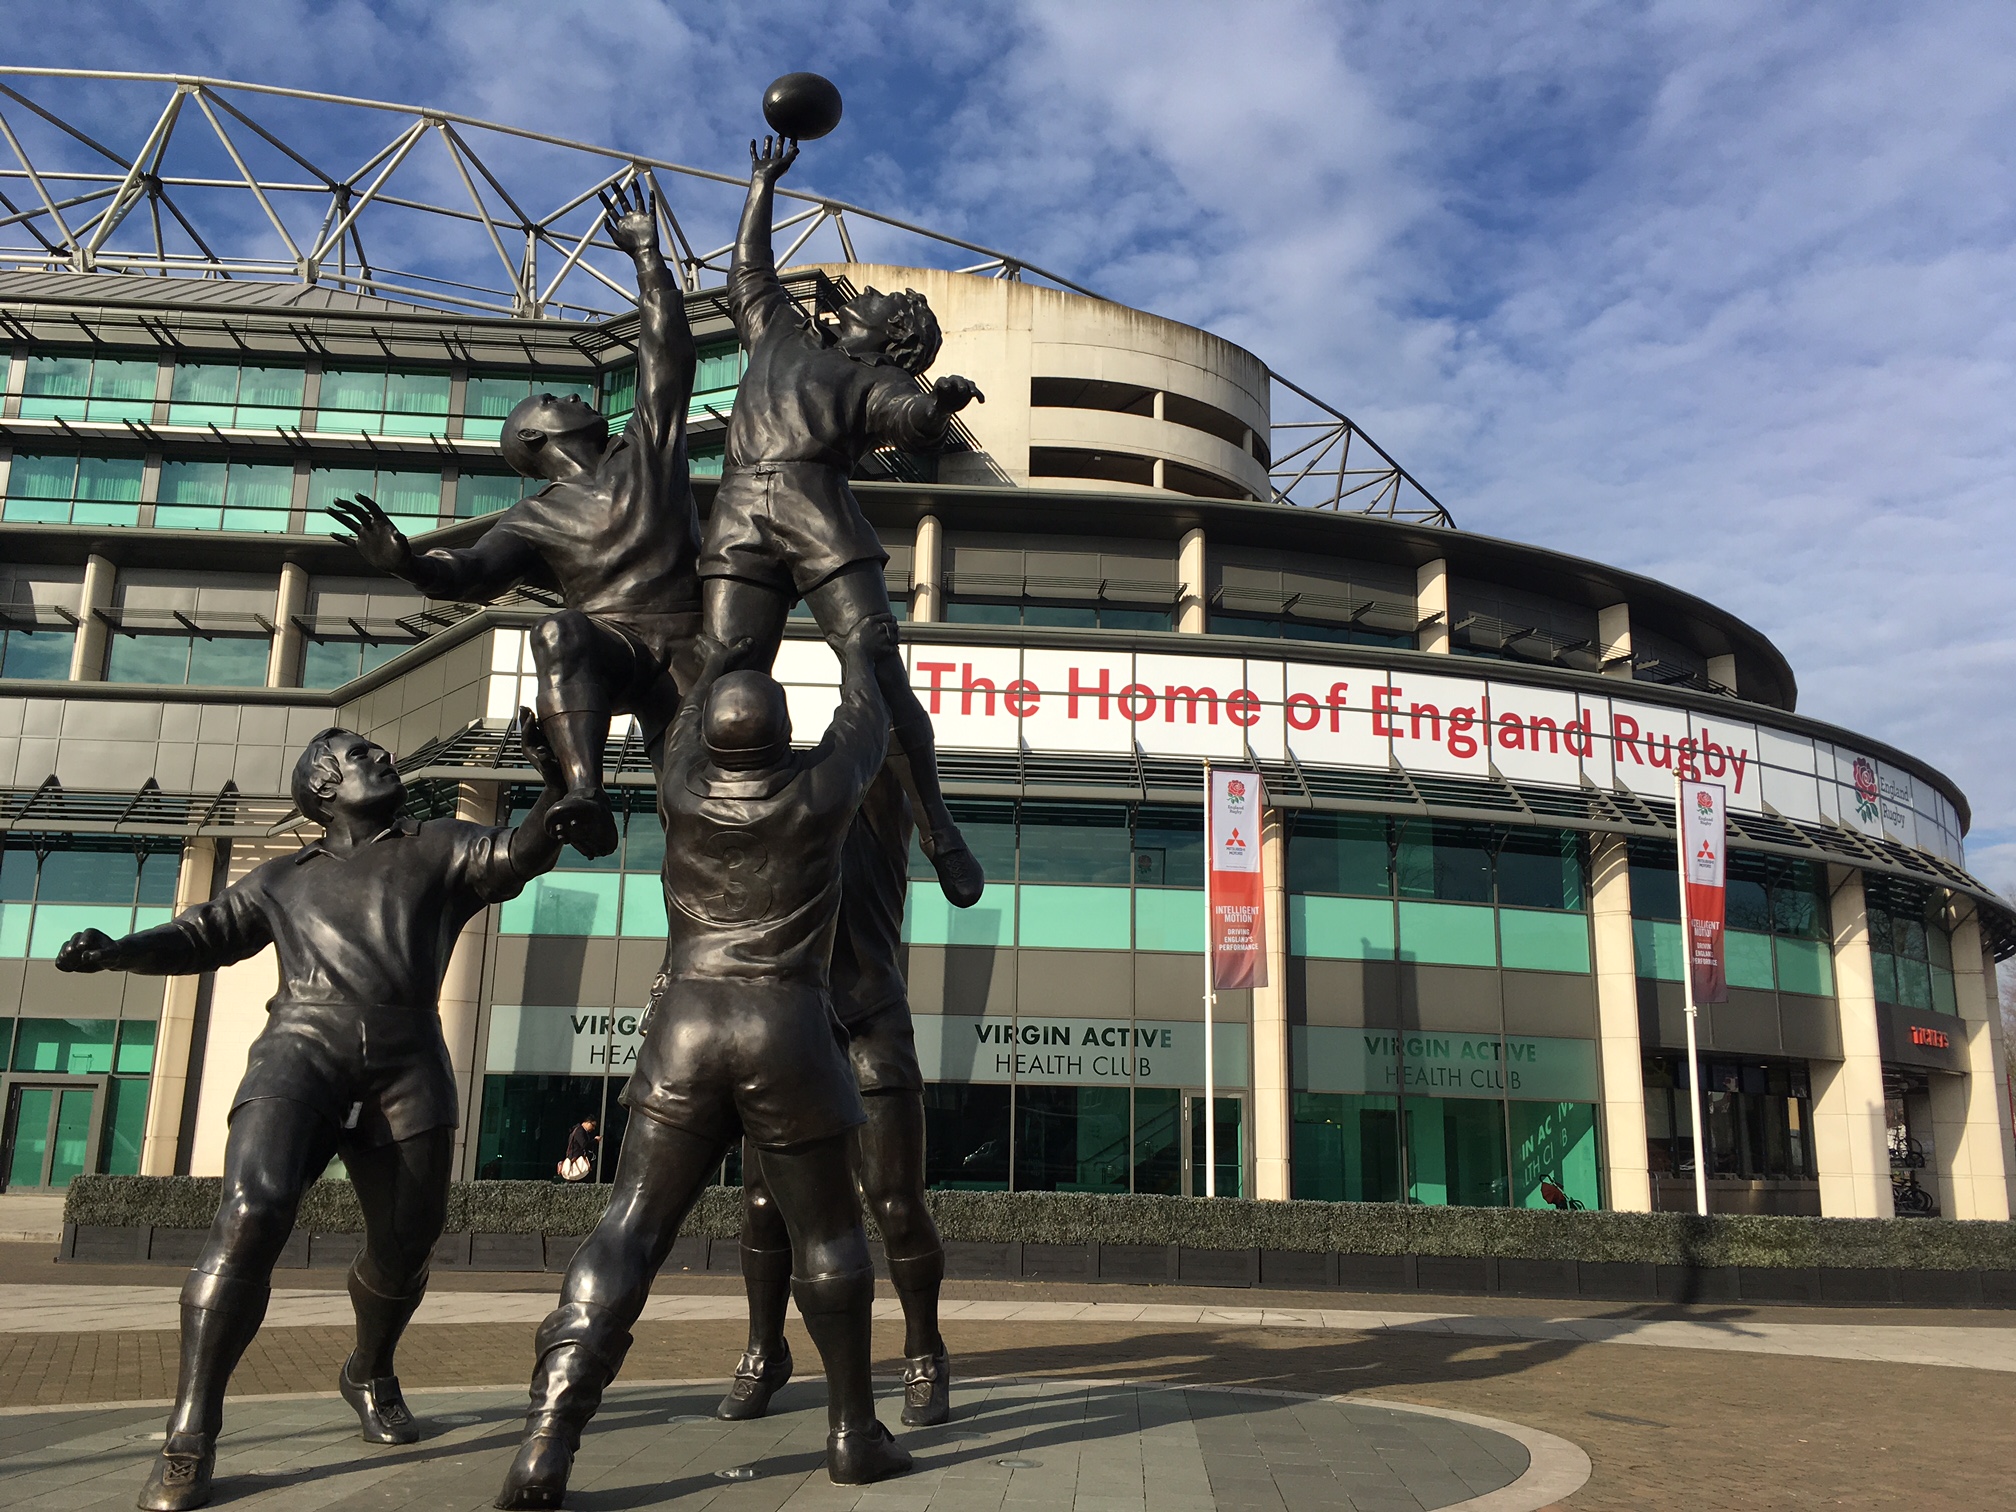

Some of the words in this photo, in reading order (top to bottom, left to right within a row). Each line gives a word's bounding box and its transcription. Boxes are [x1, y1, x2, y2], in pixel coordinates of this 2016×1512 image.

[917, 662, 1040, 718] The
[1068, 667, 1261, 728] Home
[1287, 682, 1348, 733] of
[1372, 685, 1593, 759] England
[1614, 714, 1747, 794] Rugby
[1880, 777, 1910, 802] England
[1883, 803, 1905, 828] Rugby
[1215, 906, 1259, 915] INTELLIGENT
[1224, 914, 1253, 923] MOTION
[1219, 943, 1259, 951] PERFORMANCE
[570, 1015, 637, 1036] VIRG
[974, 1024, 1071, 1046] VIRGIN
[1081, 1027, 1172, 1048] ACTIVE
[590, 1045, 637, 1065] HEA
[1364, 1036, 1450, 1058] VIRGIN
[1460, 1041, 1536, 1062] ACTIVE
[995, 1054, 1082, 1075] HEALTH
[1092, 1056, 1152, 1077] CLUB
[1385, 1065, 1462, 1087] HEALTH
[1470, 1069, 1521, 1090] CLUB
